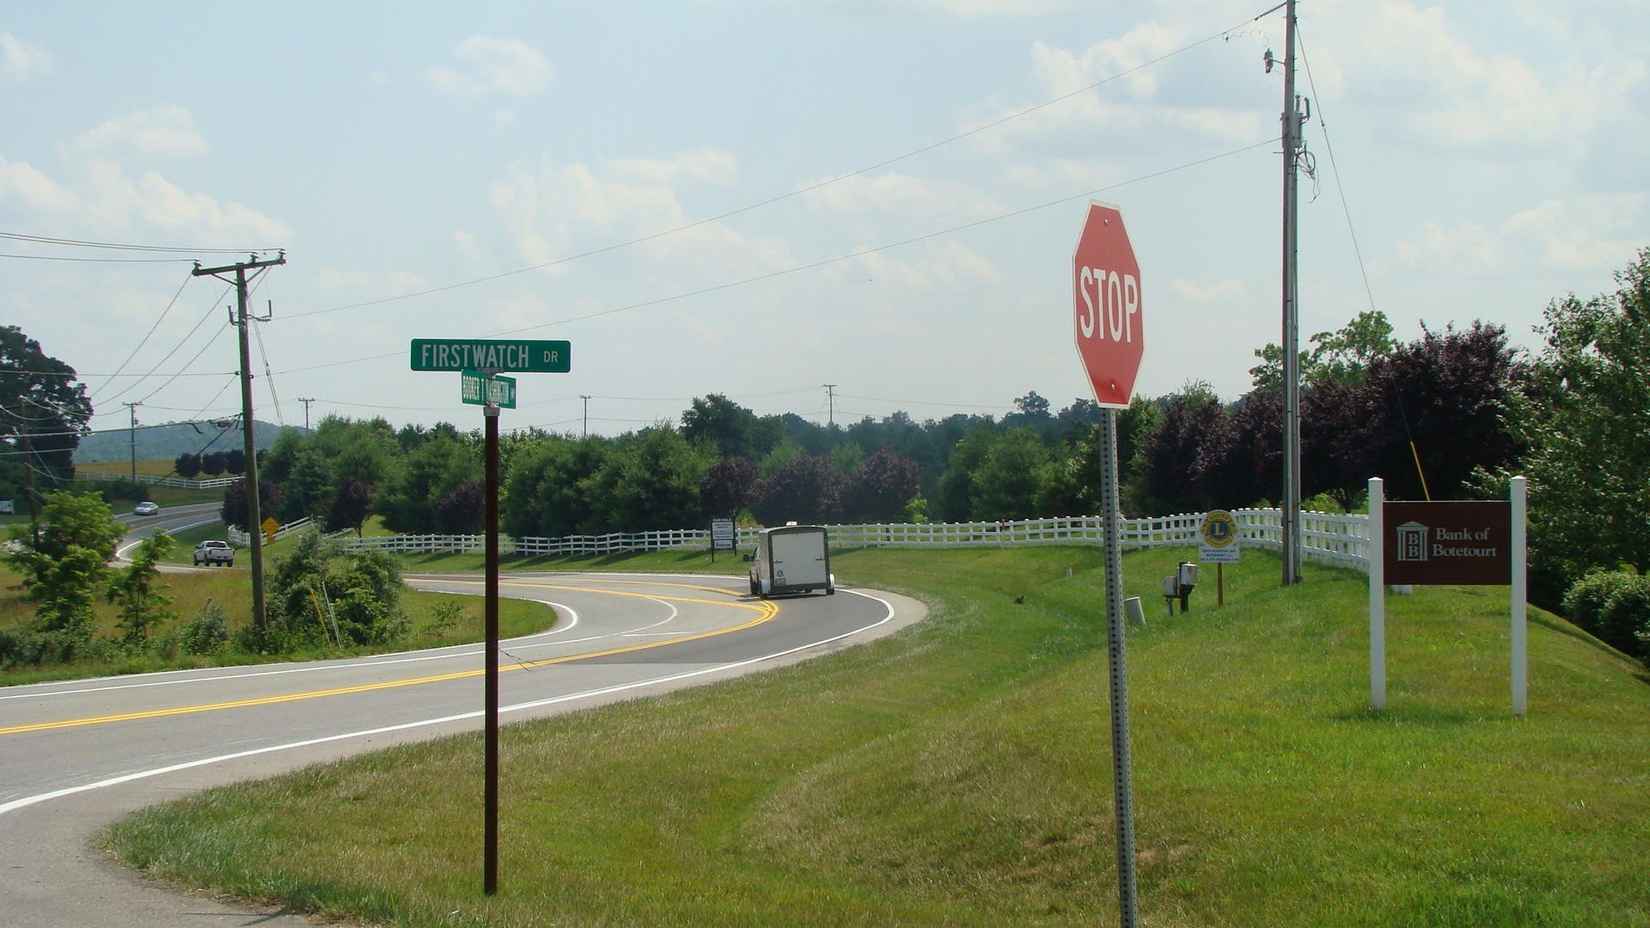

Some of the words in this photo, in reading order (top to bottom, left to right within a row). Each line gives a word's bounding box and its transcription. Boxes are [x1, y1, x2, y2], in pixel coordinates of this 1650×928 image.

[1080, 265, 1138, 343] STOP
[421, 344, 529, 368] FIRSTWATCH
[543, 350, 560, 363] DR
[1436, 527, 1473, 541] Bank
[1475, 527, 1491, 541] of
[1432, 543, 1497, 557] Botetourt
